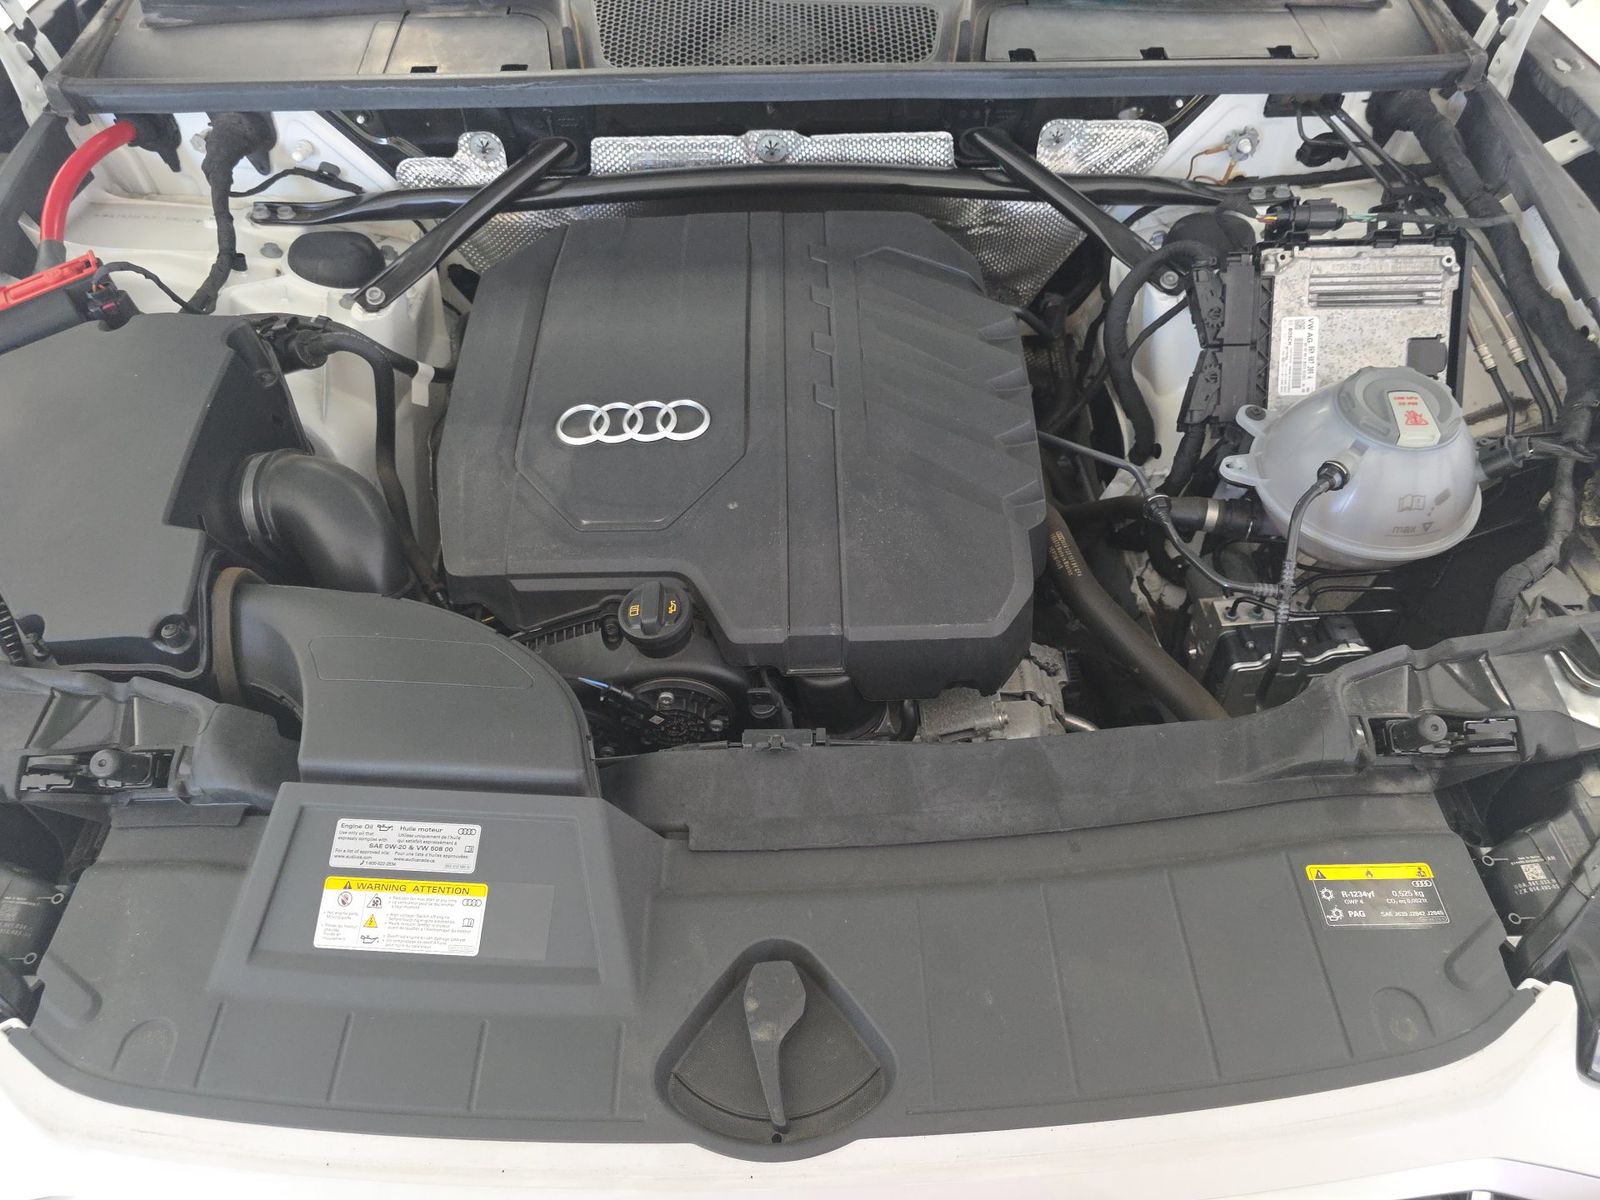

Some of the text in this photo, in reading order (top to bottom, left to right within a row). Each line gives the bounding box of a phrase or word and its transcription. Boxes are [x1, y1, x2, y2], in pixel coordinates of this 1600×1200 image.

[1308, 318, 1314, 330] VW
[1306, 332, 1313, 344] AG
[1392, 526, 1416, 534] max
[357, 882, 470, 894] WARNING ATTENTION
